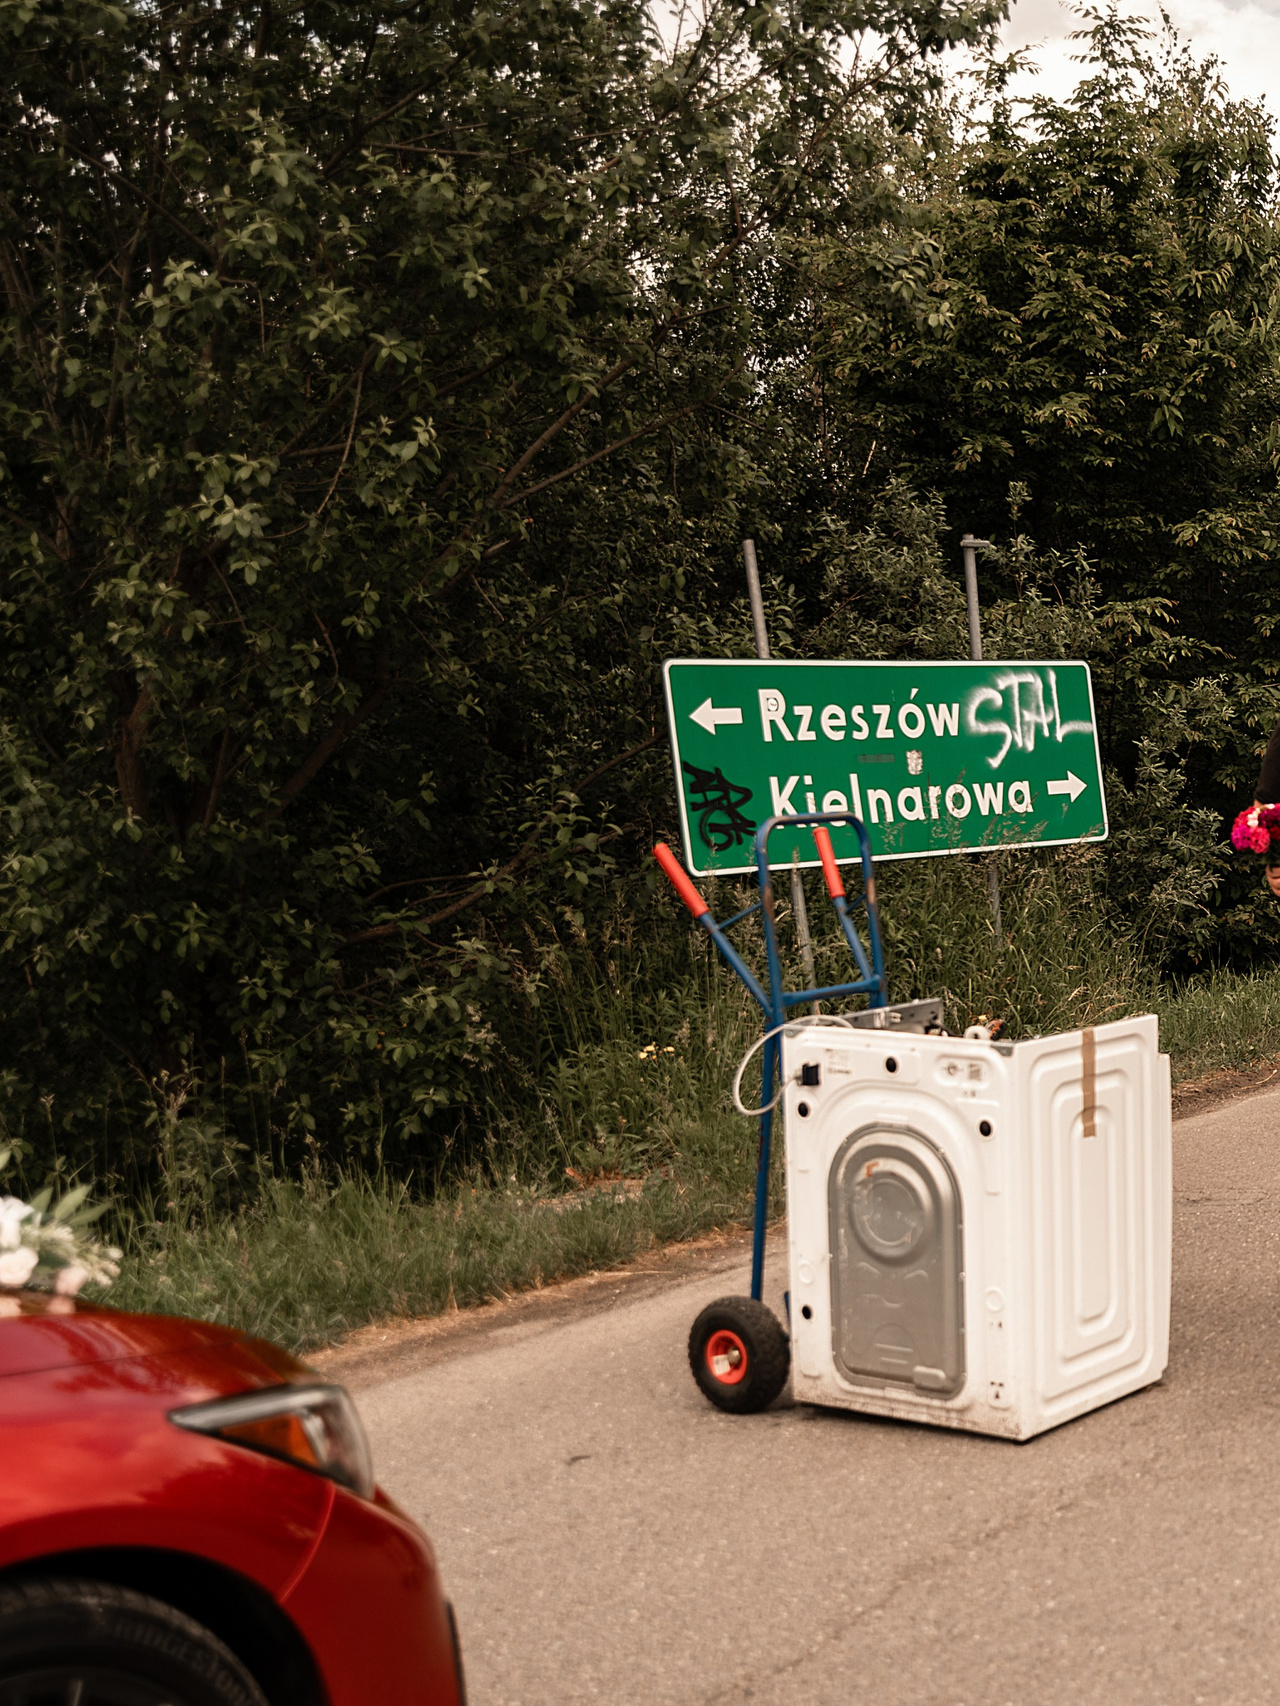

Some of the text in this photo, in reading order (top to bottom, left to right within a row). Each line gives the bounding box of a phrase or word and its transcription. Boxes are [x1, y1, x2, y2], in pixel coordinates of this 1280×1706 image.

[758, 688, 960, 742] Rzeszów
[968, 667, 1093, 768] STAL
[769, 773, 1034, 829] Kielnarowa
